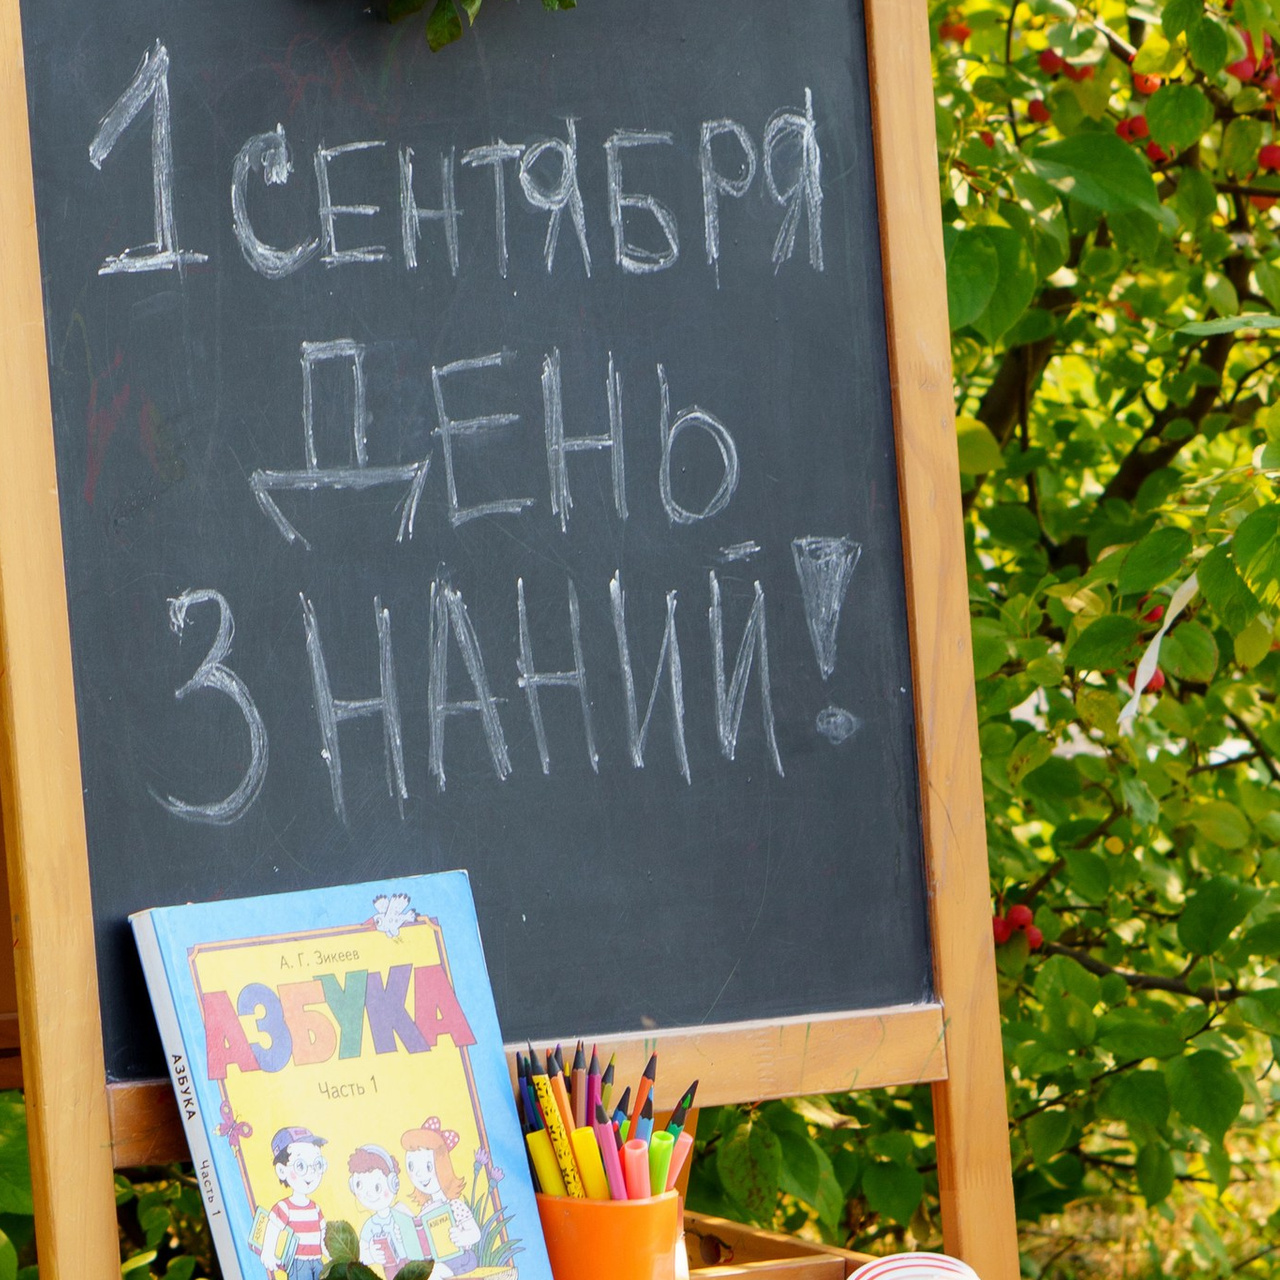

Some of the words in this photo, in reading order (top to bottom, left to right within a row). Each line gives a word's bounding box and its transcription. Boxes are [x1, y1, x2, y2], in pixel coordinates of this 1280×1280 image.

[87, 37, 210, 276] 1
[231, 86, 826, 288] СЕНТЯБРЯ
[247, 336, 740, 551] ДЕНЬ
[279, 955, 295, 970] А.
[297, 952, 310, 967] Г.
[314, 948, 361, 965] Зикеев
[202, 963, 477, 1081] АЗБУКА
[171, 1053, 197, 1121] АЗБУКА
[318, 1079, 366, 1101] Часть
[370, 1074, 379, 1094] 1
[199, 1159, 214, 1204] Часть
[211, 1209, 222, 1217] 1
